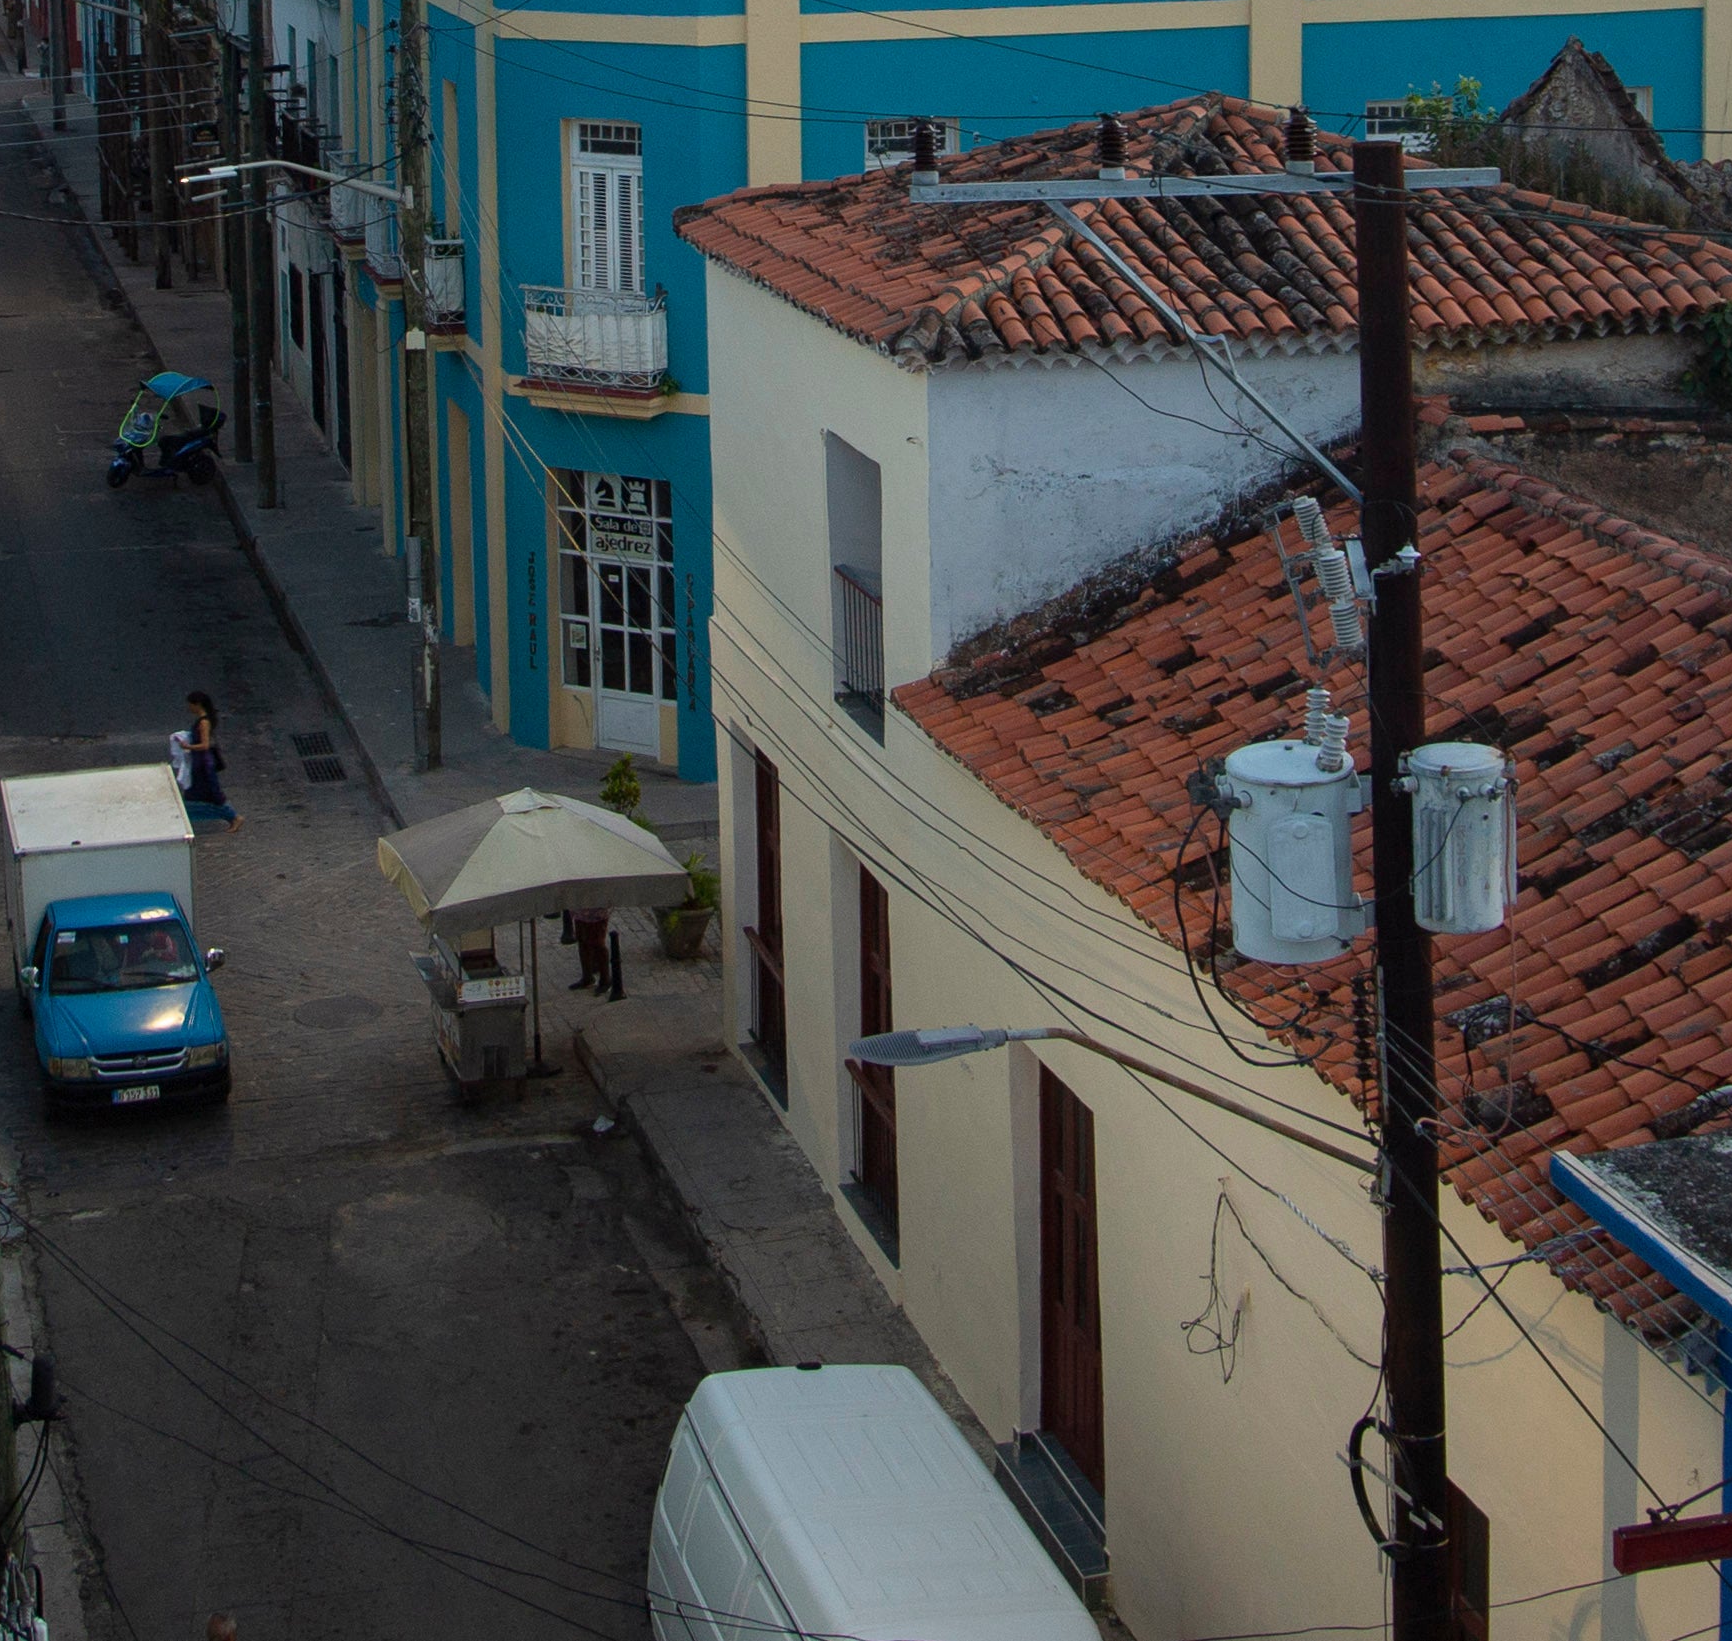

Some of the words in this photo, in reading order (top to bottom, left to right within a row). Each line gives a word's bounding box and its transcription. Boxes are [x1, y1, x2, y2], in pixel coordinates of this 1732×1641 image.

[594, 516, 620, 531] Sala
[623, 520, 638, 533] de
[595, 534, 652, 555] ajedrez
